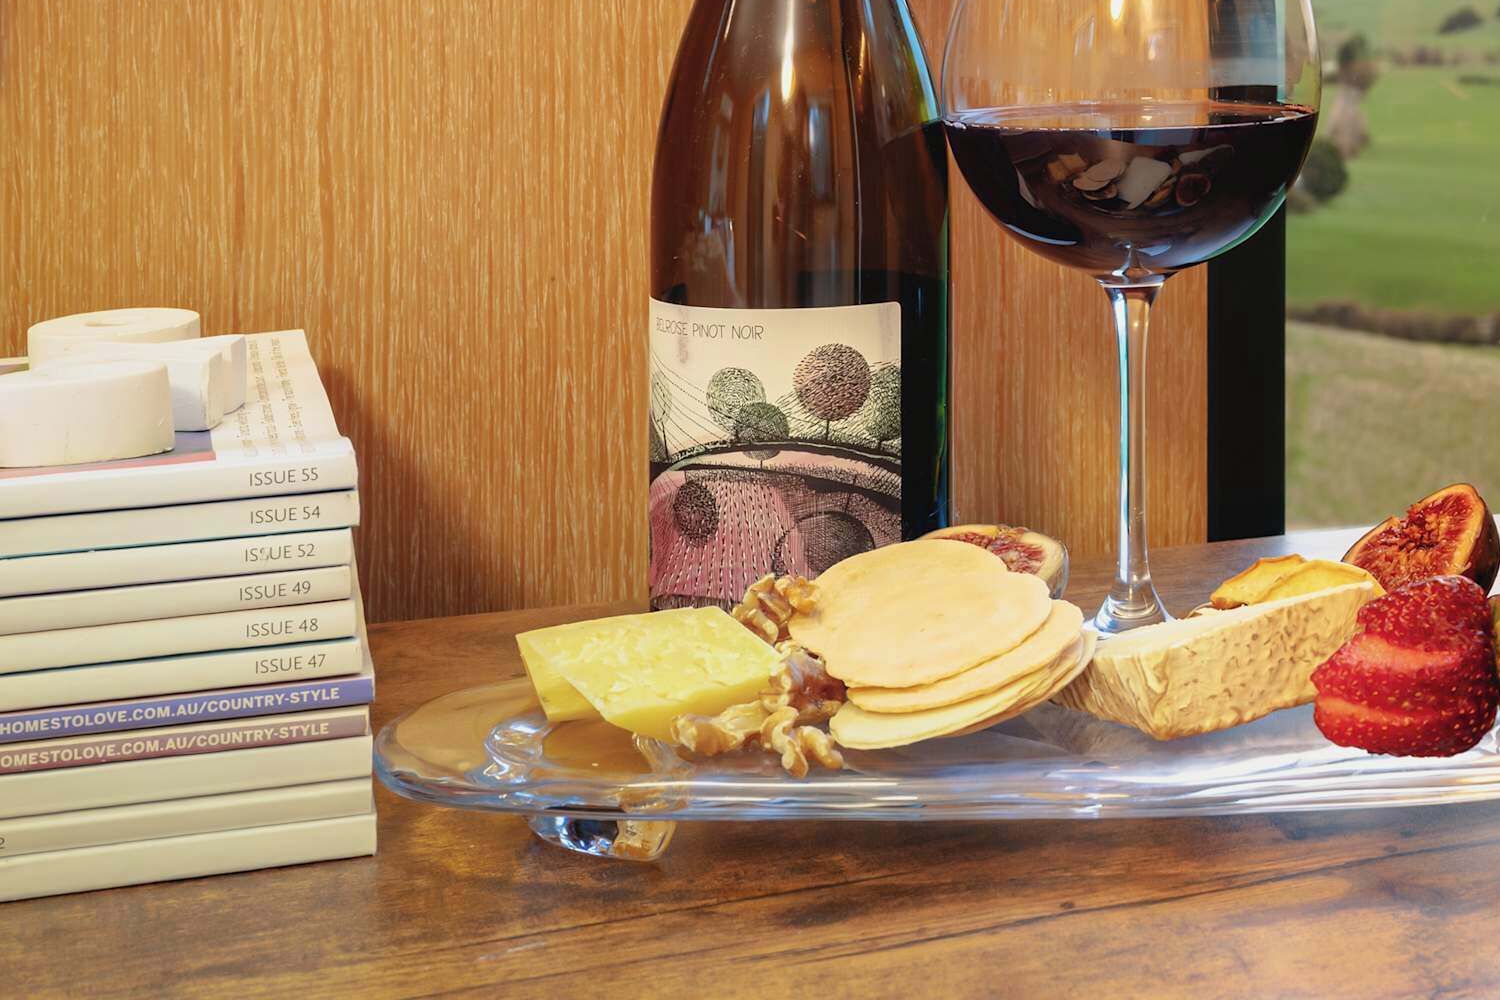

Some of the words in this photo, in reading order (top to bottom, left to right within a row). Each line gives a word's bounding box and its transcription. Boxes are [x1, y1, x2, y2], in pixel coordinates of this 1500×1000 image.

[692, 322, 726, 339] PINOT
[731, 325, 765, 340] NOIR
[248, 469, 297, 487] ISSUE
[302, 467, 319, 482] 55
[250, 507, 298, 525] ISSUE
[302, 505, 321, 520] 54
[244, 545, 293, 563] ISSUE
[298, 543, 316, 558] 52
[239, 583, 288, 601] ISSUE
[292, 580, 312, 595] 49
[245, 620, 294, 638] ISSUE
[298, 617, 319, 633] 48
[255, 656, 304, 675] ISSUE
[308, 653, 327, 668] 47
